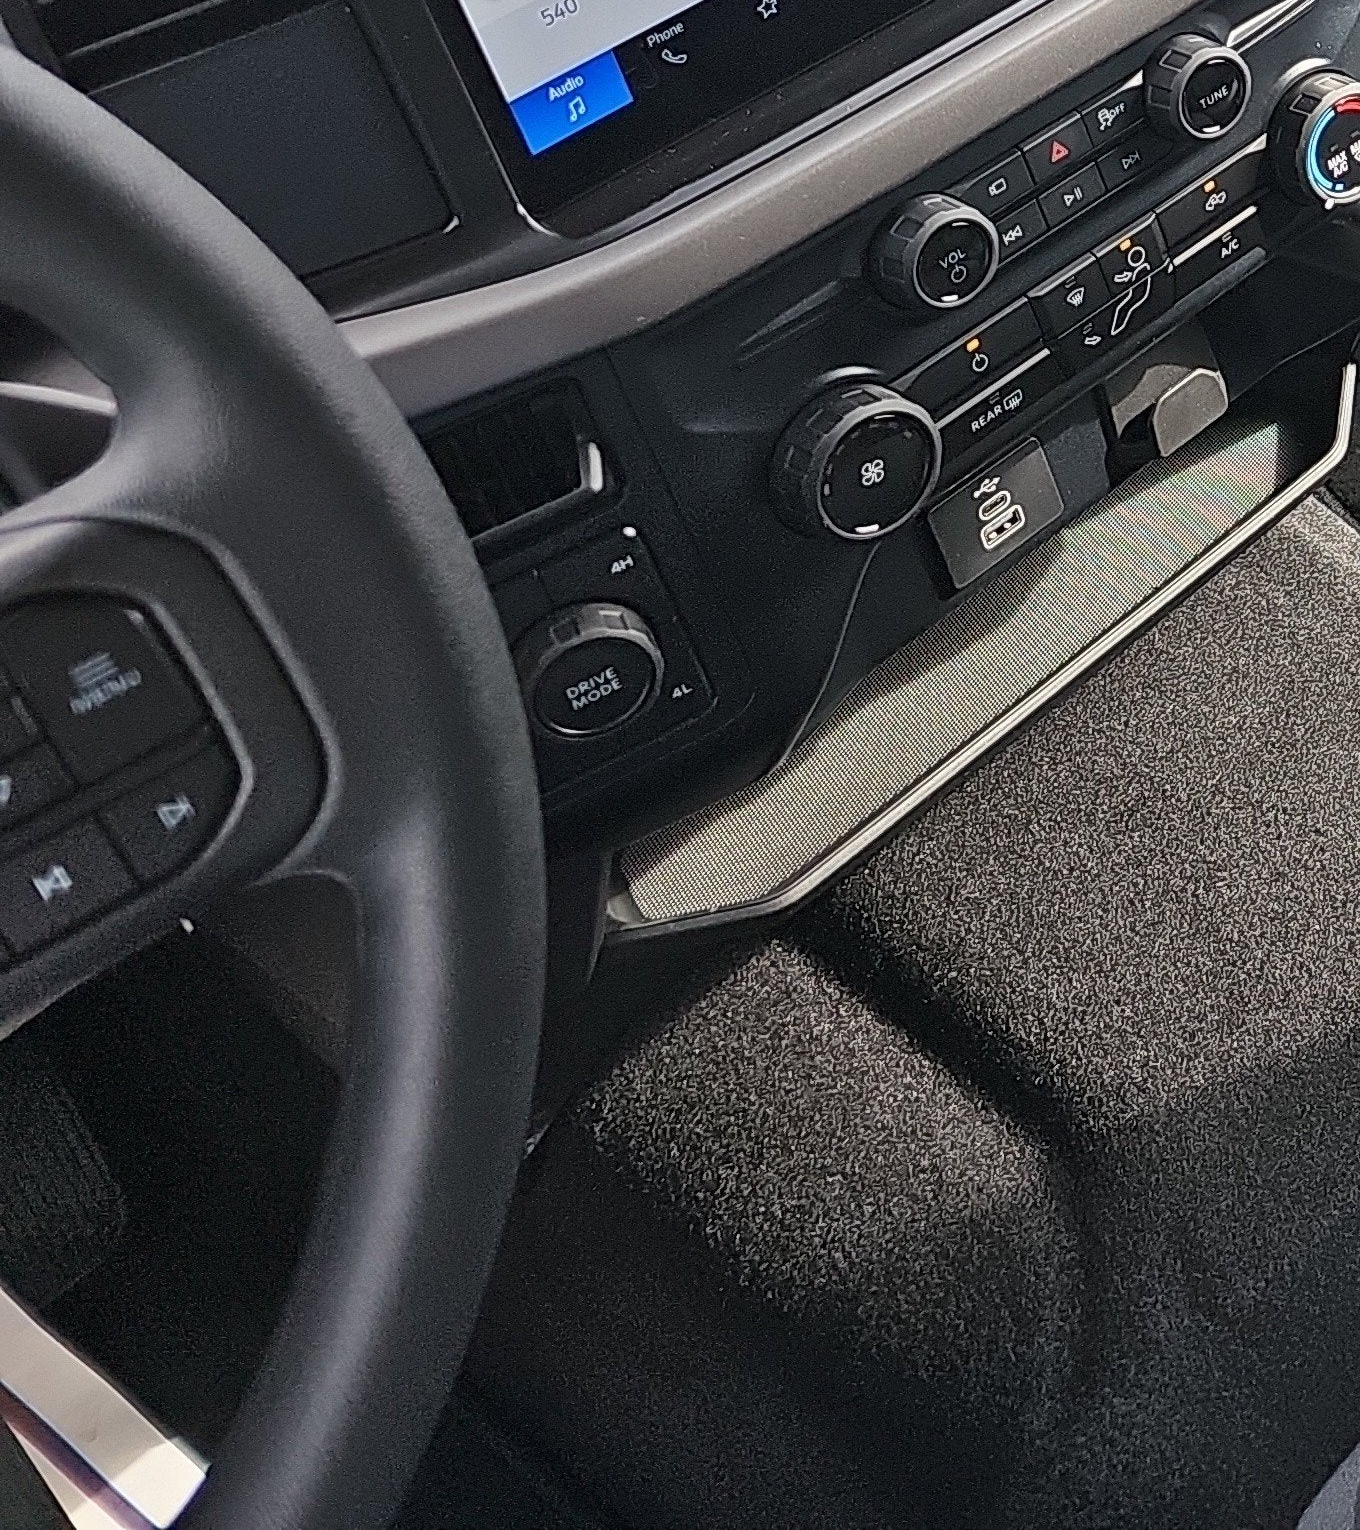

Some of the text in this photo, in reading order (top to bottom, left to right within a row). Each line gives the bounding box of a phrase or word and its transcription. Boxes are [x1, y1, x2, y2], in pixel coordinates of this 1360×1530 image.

[646, 22, 685, 48] Phone
[549, 74, 584, 101] Audio
[1199, 85, 1229, 110] TUNE
[1110, 102, 1126, 119] OFF
[1327, 150, 1348, 170] MAX
[939, 249, 967, 269] VOL
[1220, 239, 1240, 258] A/C
[971, 405, 1002, 432] REAR
[610, 555, 635, 574] 4H
[565, 667, 618, 701] DRIVE
[571, 678, 624, 711] MODE
[671, 684, 693, 700] 4L
